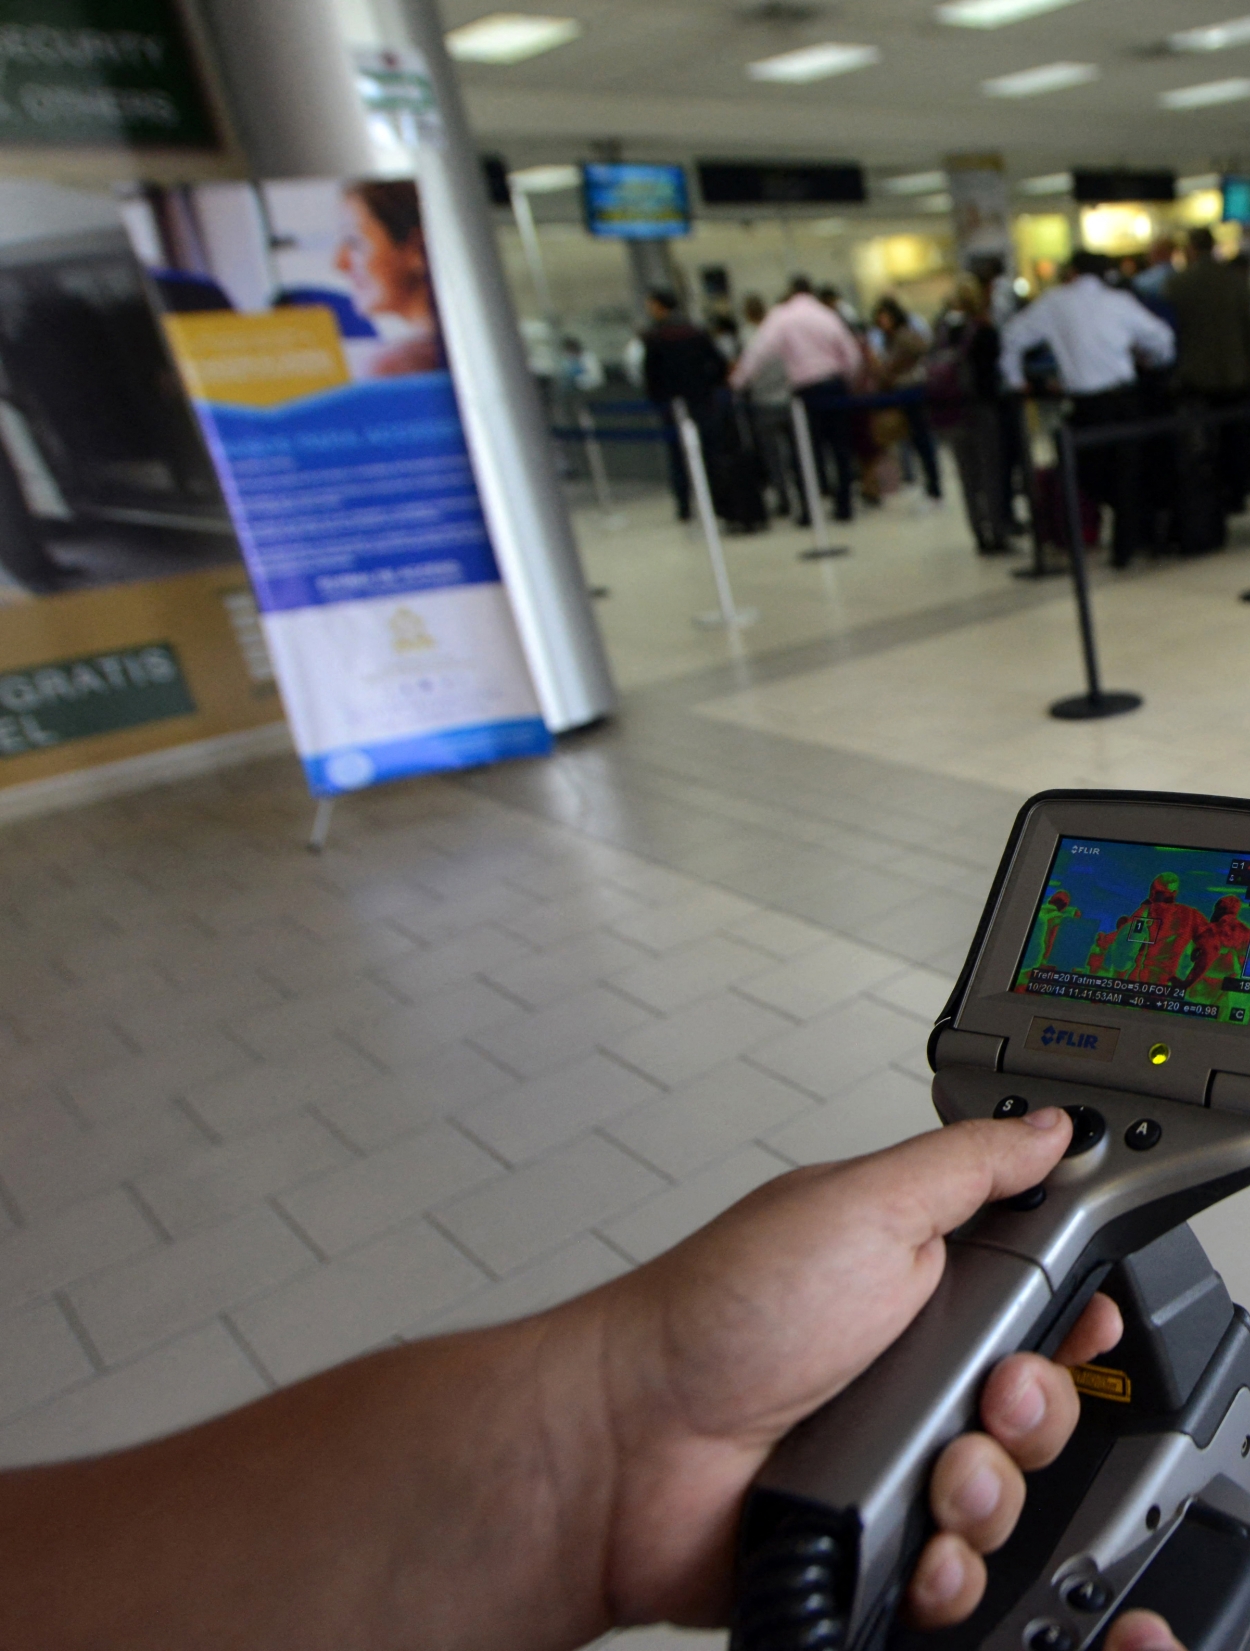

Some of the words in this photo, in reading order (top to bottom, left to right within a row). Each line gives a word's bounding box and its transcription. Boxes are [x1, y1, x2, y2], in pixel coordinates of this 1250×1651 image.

[0, 646, 177, 712] GRATIS
[1078, 846, 1100, 855] FLIR
[1072, 974, 1113, 988] Tatm=25
[1149, 985, 1171, 995] FOV
[1173, 988, 1186, 998] 24
[1028, 982, 1066, 995] 10/20/14
[1156, 1000, 1180, 1011] +120
[1055, 1030, 1099, 1050] FLIR
[1002, 1099, 1014, 1111] S
[1136, 1122, 1148, 1136] A
